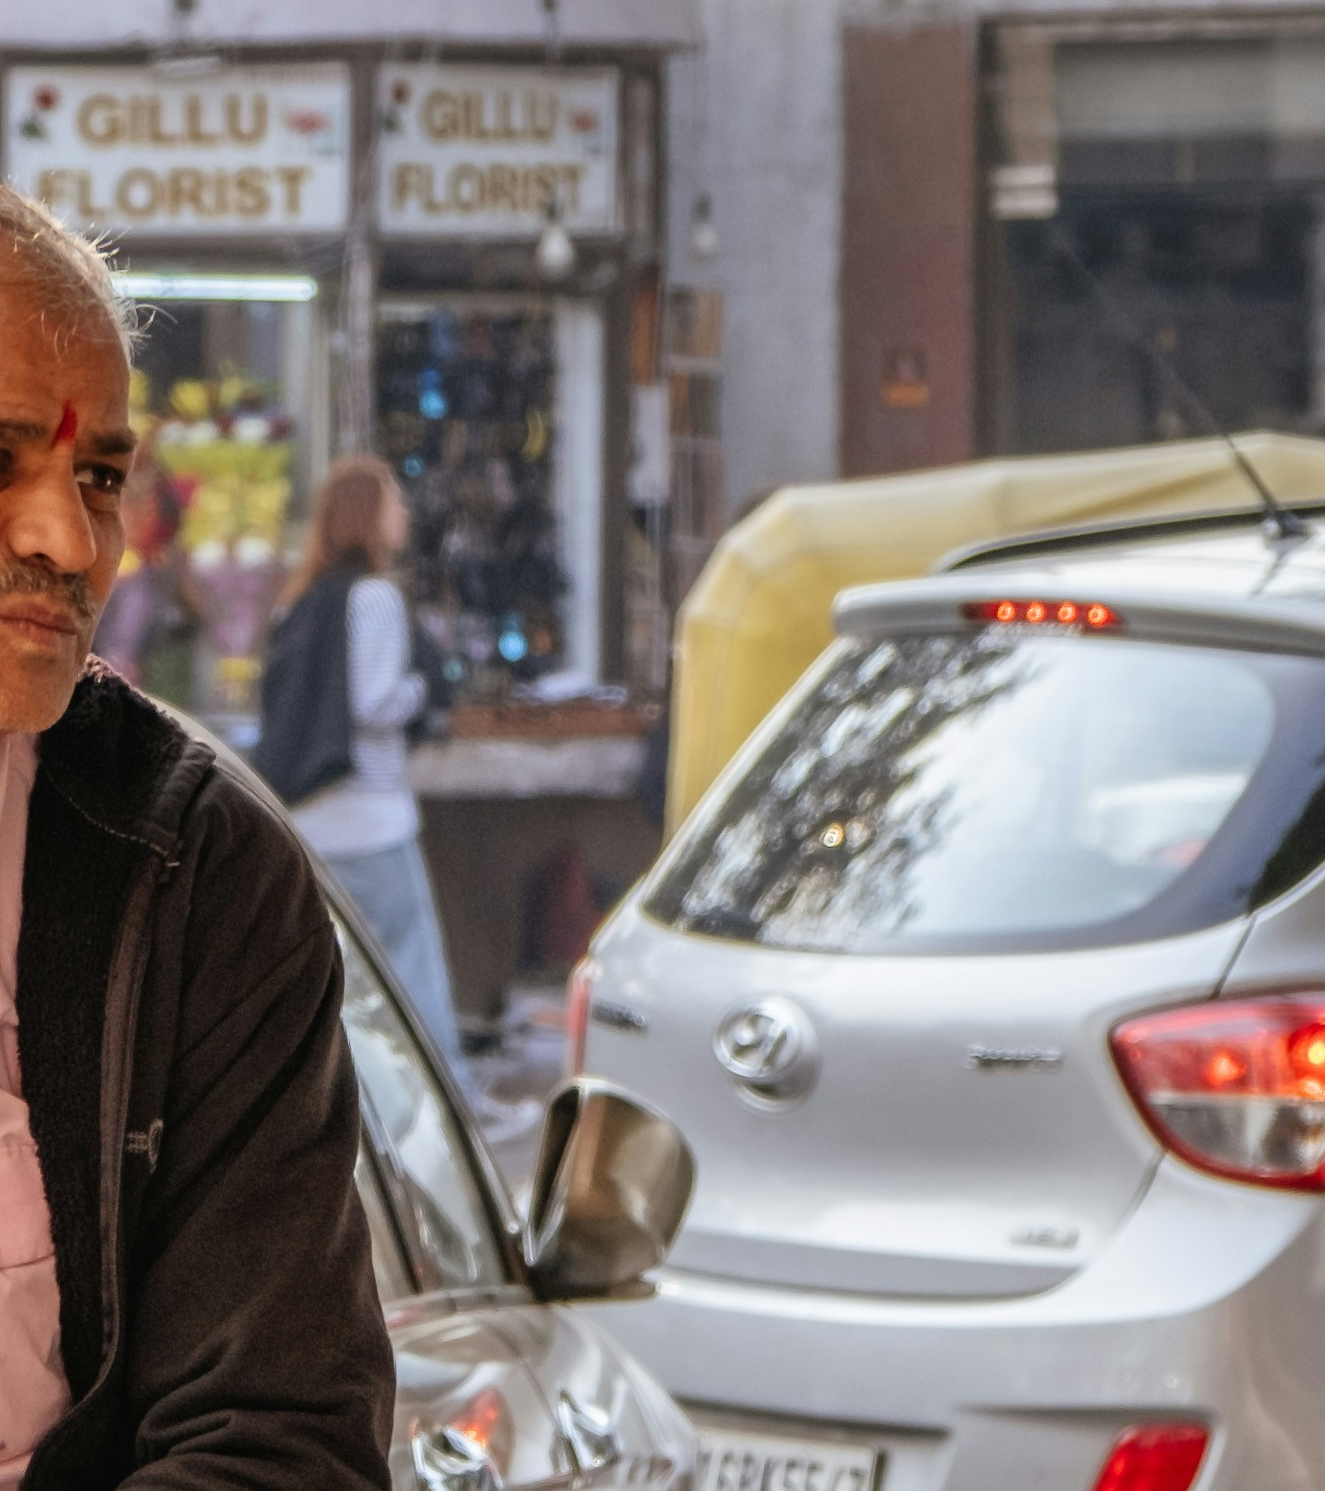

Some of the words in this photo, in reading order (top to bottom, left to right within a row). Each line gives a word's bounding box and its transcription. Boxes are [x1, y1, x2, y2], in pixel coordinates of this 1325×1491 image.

[77, 92, 269, 150] GILLU
[420, 87, 561, 146] GILLU
[38, 165, 312, 219] FLORIST
[394, 161, 586, 216] FLORIST
